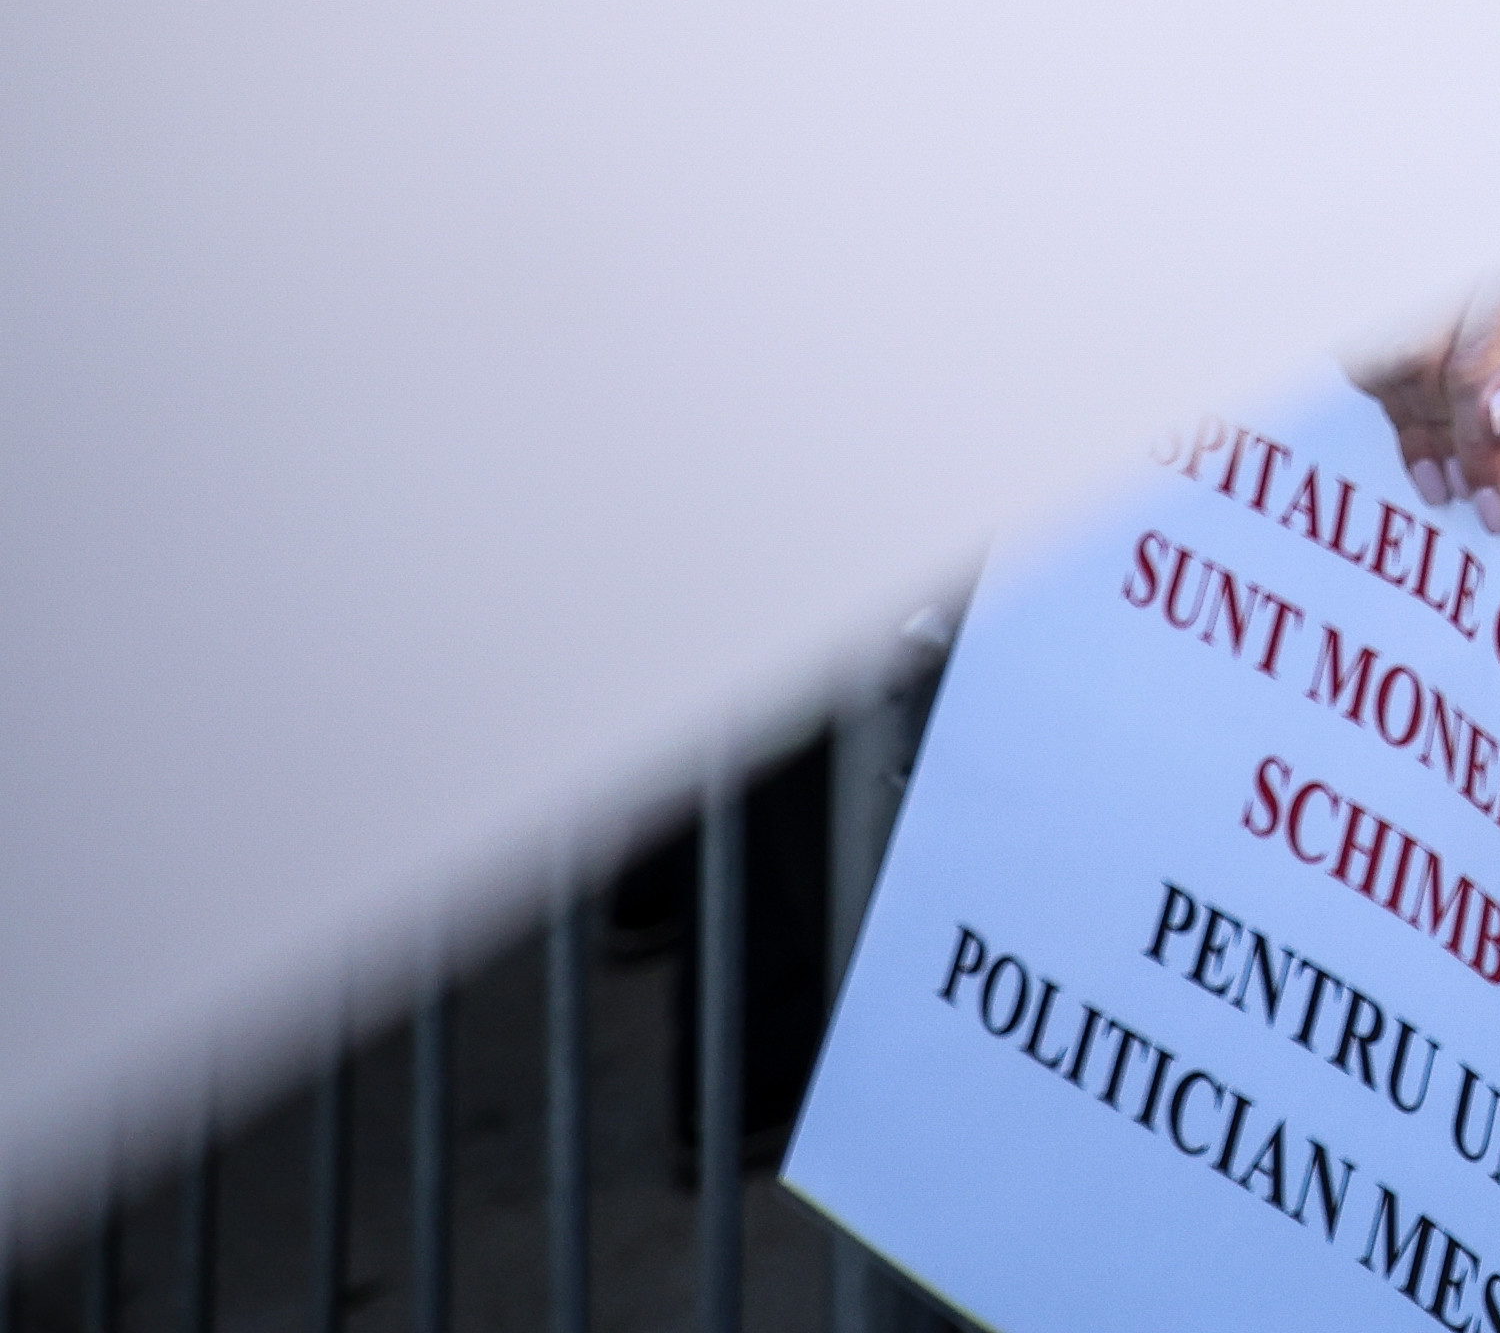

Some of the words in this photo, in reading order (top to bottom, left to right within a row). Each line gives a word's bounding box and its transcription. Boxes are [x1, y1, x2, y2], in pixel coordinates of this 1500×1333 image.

[1122, 529, 1303, 680] SUNT
[936, 922, 1356, 1243] POLITICIAN
[1142, 877, 1441, 1115] PENTRU
